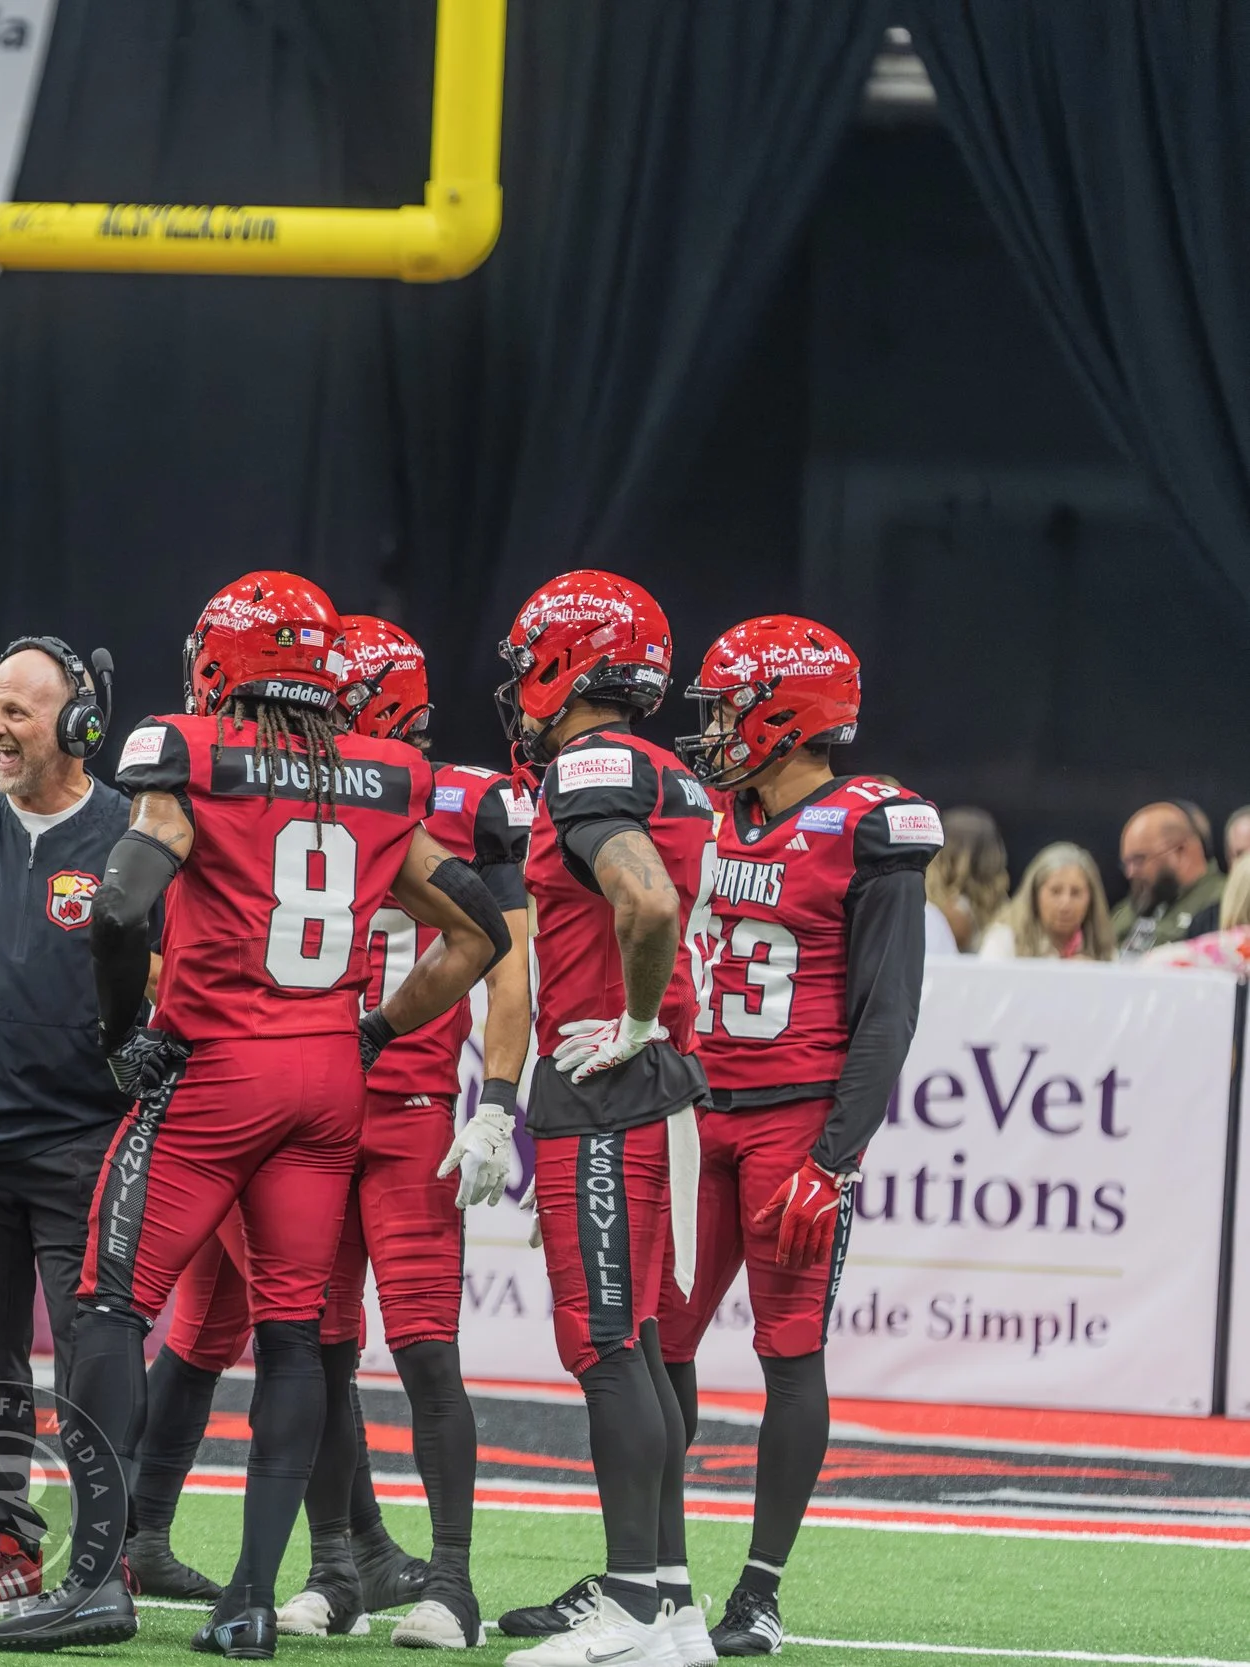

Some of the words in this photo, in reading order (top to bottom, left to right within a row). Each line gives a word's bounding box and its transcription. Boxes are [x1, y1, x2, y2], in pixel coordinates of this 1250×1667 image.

[209, 597, 231, 611] HCA
[231, 600, 278, 624] Florida
[577, 593, 633, 617] Florida
[203, 613, 251, 631] Healthcare
[541, 608, 606, 624] Healthcare
[354, 645, 389, 661] HCA
[761, 647, 800, 664] HCA
[801, 646, 851, 665] Florida
[764, 662, 833, 678] Healthcare
[265, 681, 331, 706] Riddell
[570, 758, 618, 770] DARLEY'S
[244, 754, 383, 799] HUGGINS
[434, 789, 463, 802] car
[846, 782, 901, 802] 13
[802, 808, 846, 824] oscar
[715, 857, 786, 908] HARKS
[264, 818, 357, 990] 8
[854, 1150, 1128, 1236] utions
[926, 1291, 1111, 1357] Simple
